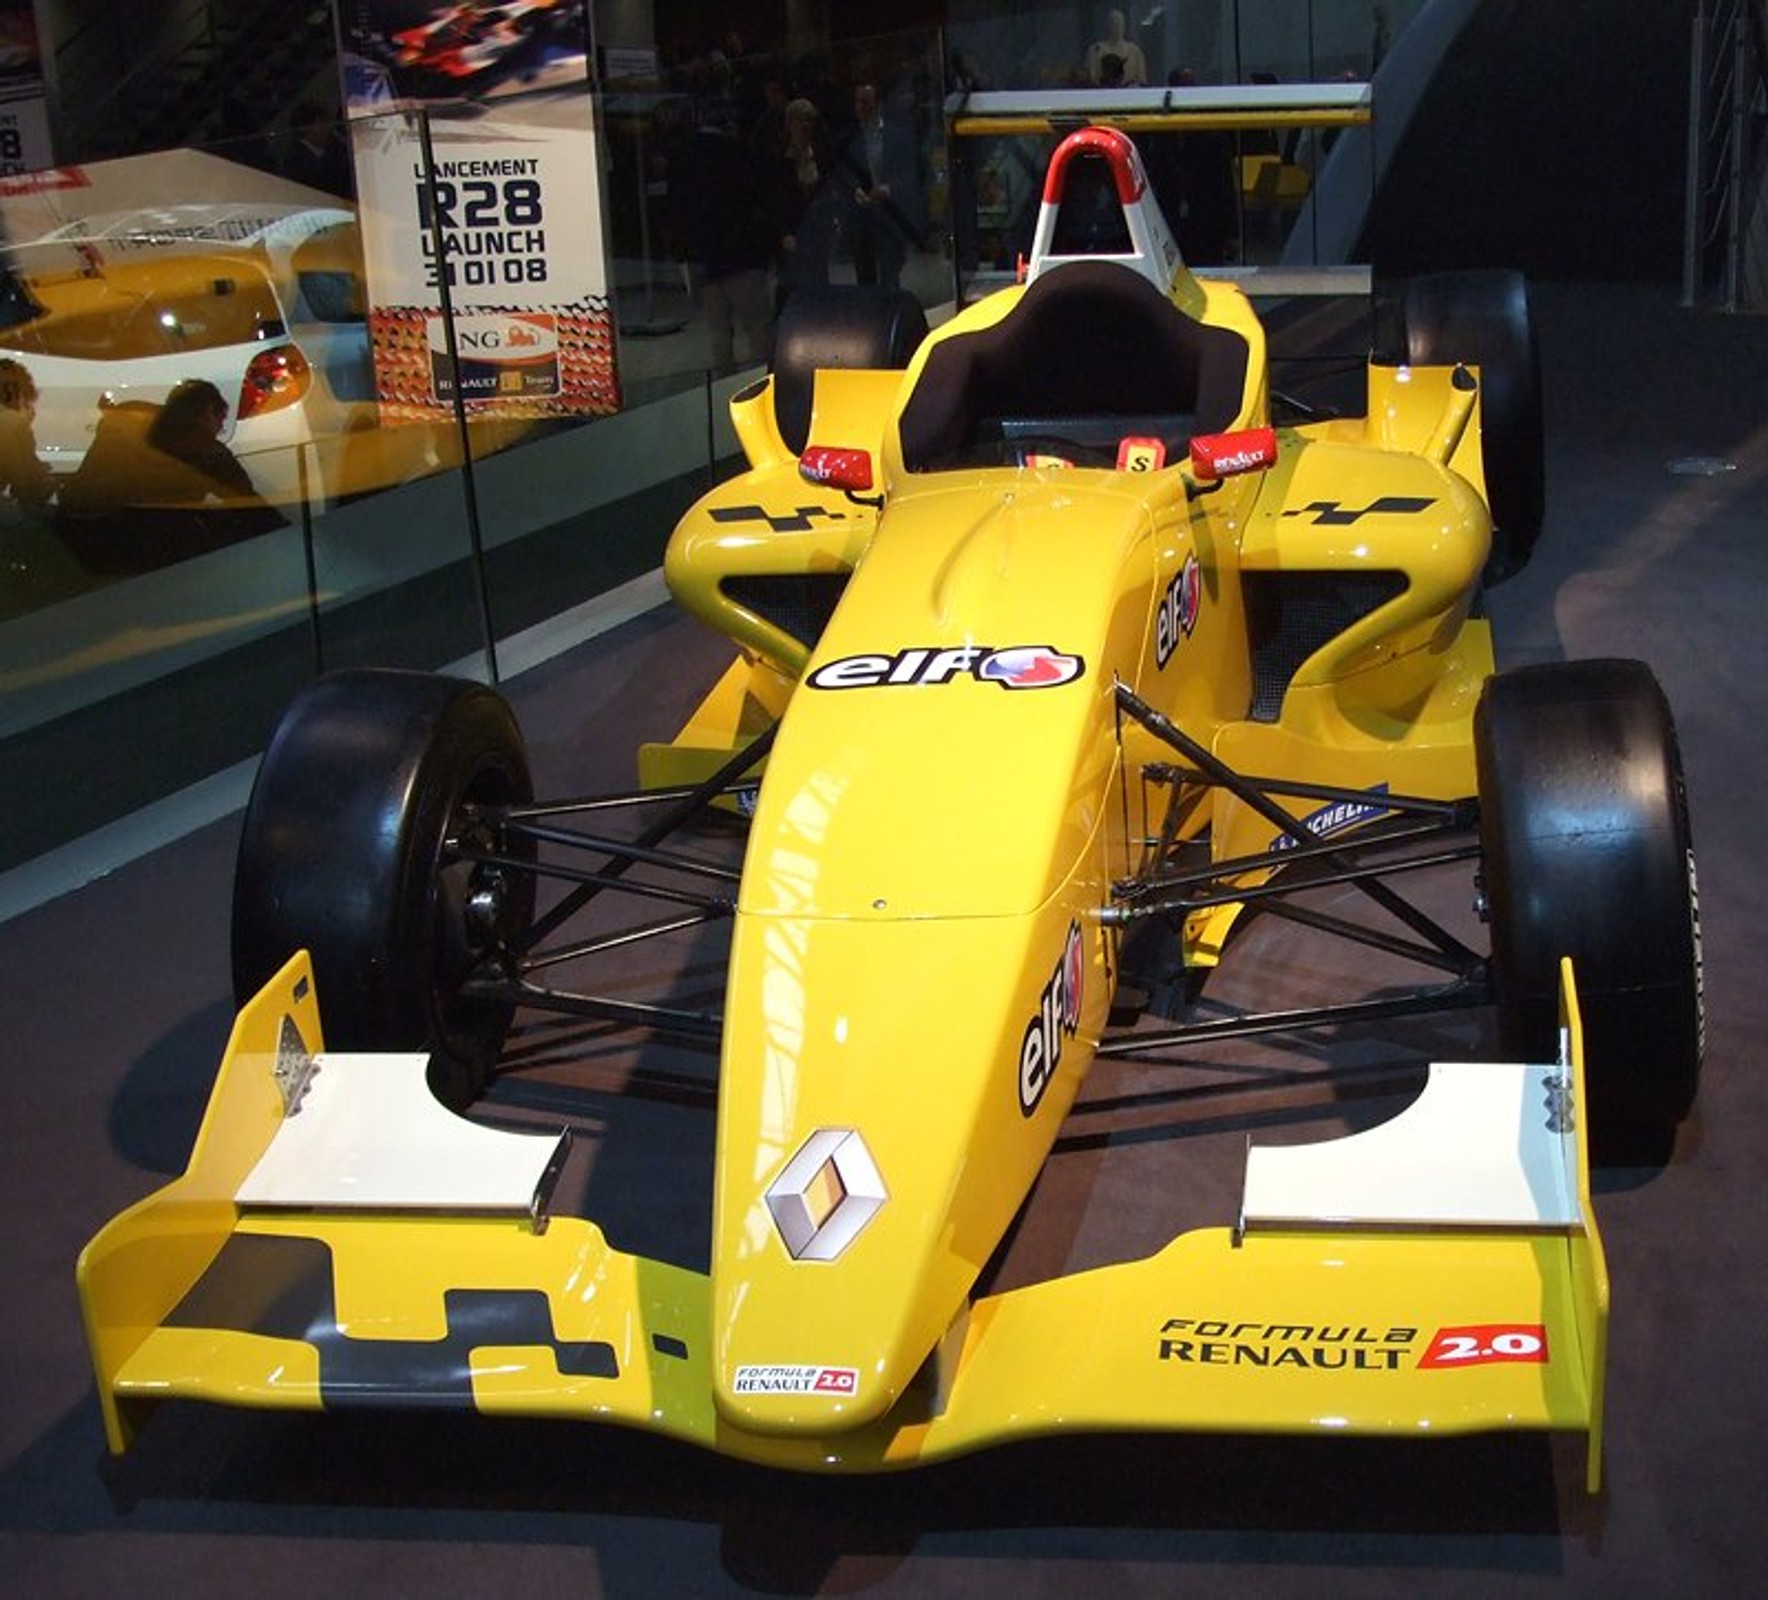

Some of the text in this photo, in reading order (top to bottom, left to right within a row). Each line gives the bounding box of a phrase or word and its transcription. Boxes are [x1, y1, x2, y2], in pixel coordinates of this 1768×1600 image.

[413, 159, 539, 179] LANCEMENT
[416, 179, 543, 229] R28
[421, 230, 545, 257] LAUNCH
[503, 258, 547, 284] 08
[459, 331, 500, 350] NG
[811, 648, 984, 688] elf
[1020, 964, 1062, 1111] elf
[1159, 1333, 1541, 1370] RENAULT 2.0
[736, 1374, 853, 1391] RENAULT 2.0
